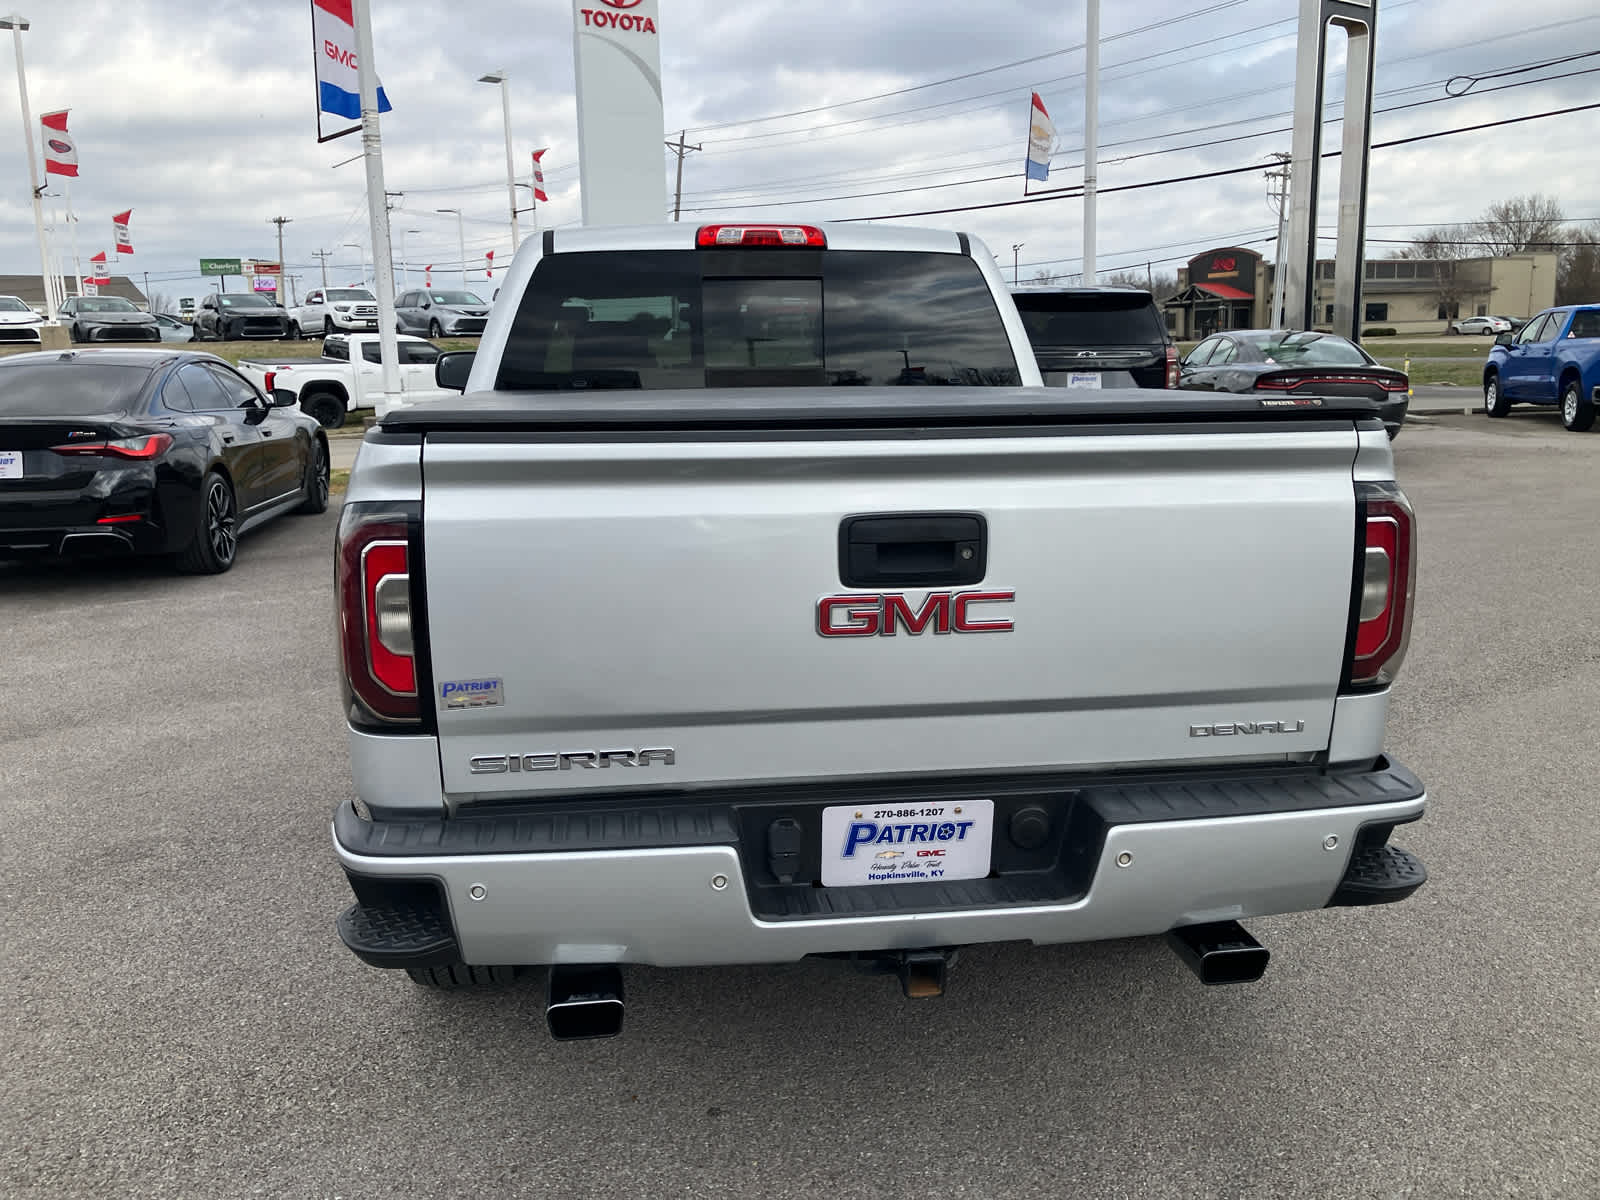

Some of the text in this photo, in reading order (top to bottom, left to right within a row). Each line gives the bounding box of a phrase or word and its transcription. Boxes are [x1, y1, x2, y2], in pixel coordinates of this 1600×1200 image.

[580, 8, 656, 34] TOYOTA
[324, 40, 358, 70] GMC
[815, 590, 1015, 637] GMC
[441, 680, 497, 698] PATRIOT
[1190, 720, 1304, 737] DENALI
[471, 748, 675, 774] SIERRA
[873, 807, 945, 819] 270-886-1207
[841, 820, 976, 859] PATRIOT
[916, 849, 946, 857] GMC
[868, 869, 945, 880] Hopkinsville, KY
